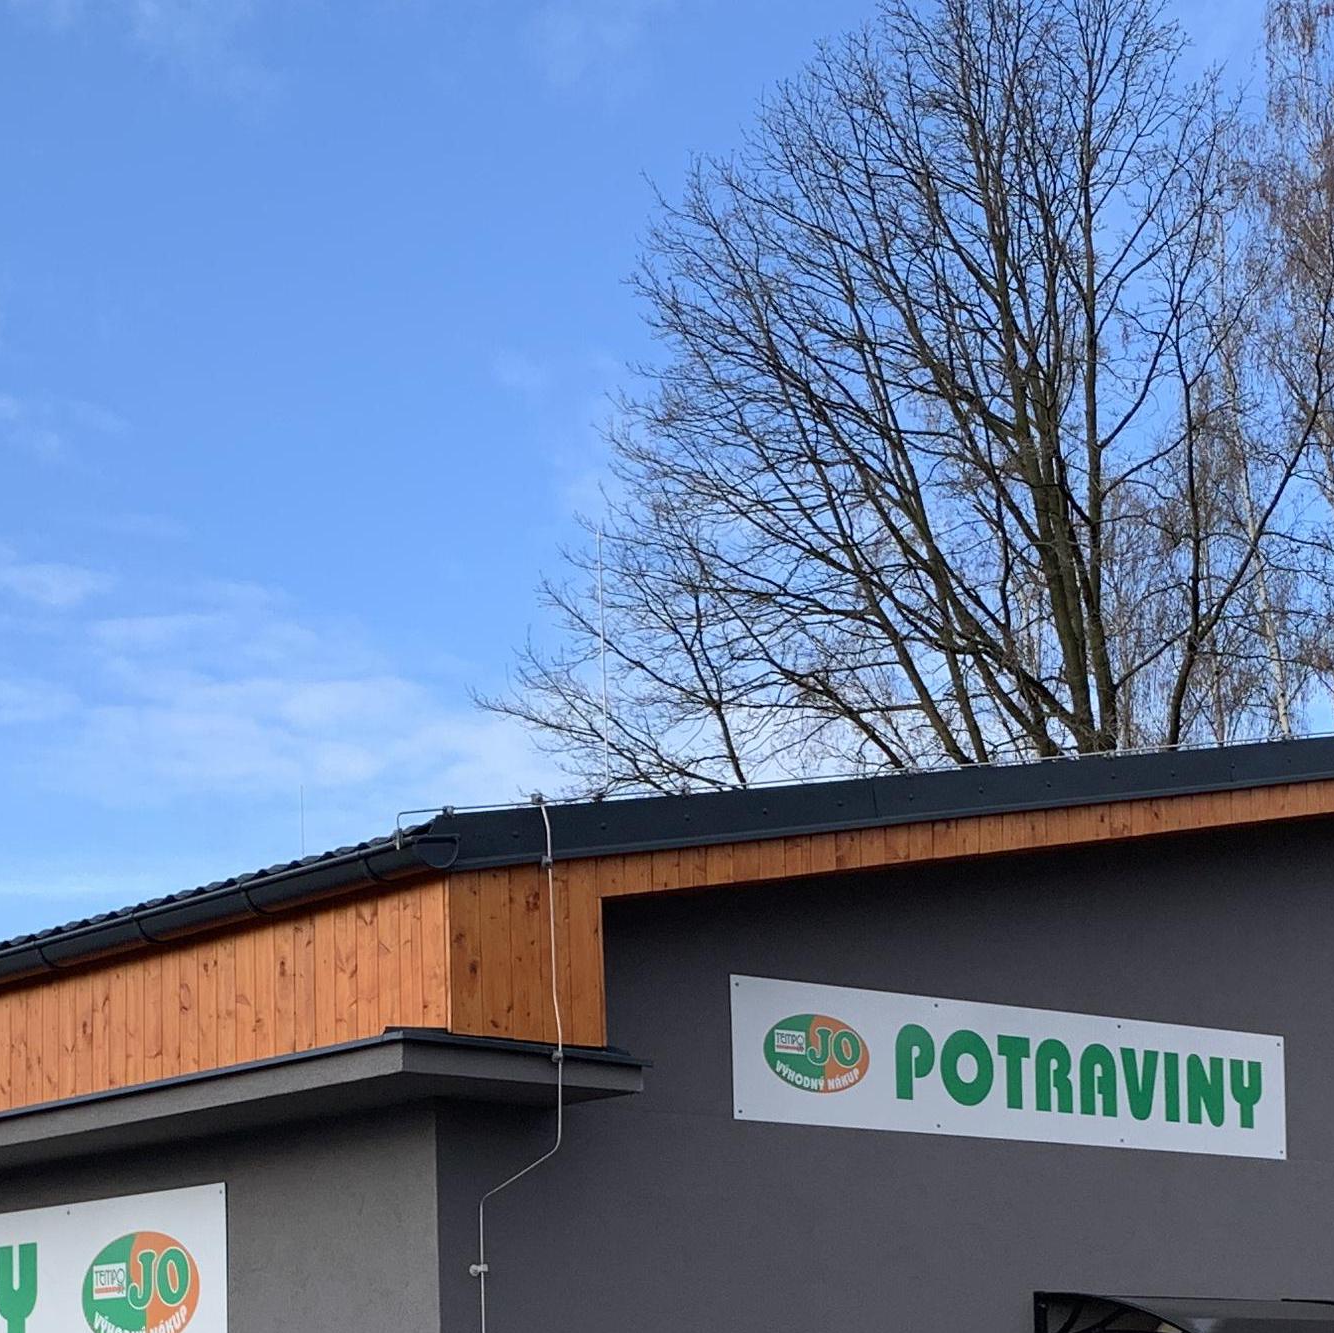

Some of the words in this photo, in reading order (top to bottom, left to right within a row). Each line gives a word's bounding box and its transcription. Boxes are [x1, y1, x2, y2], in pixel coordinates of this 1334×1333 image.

[776, 1032, 805, 1046] TEMPO
[807, 1027, 862, 1068] JO
[776, 1060, 825, 1090] VÝHODNÝ
[828, 1067, 859, 1090] NÁKUP
[894, 1022, 1263, 1130] POTRAVINY
[95, 1268, 125, 1287] TEMPO
[128, 1246, 191, 1310] JO
